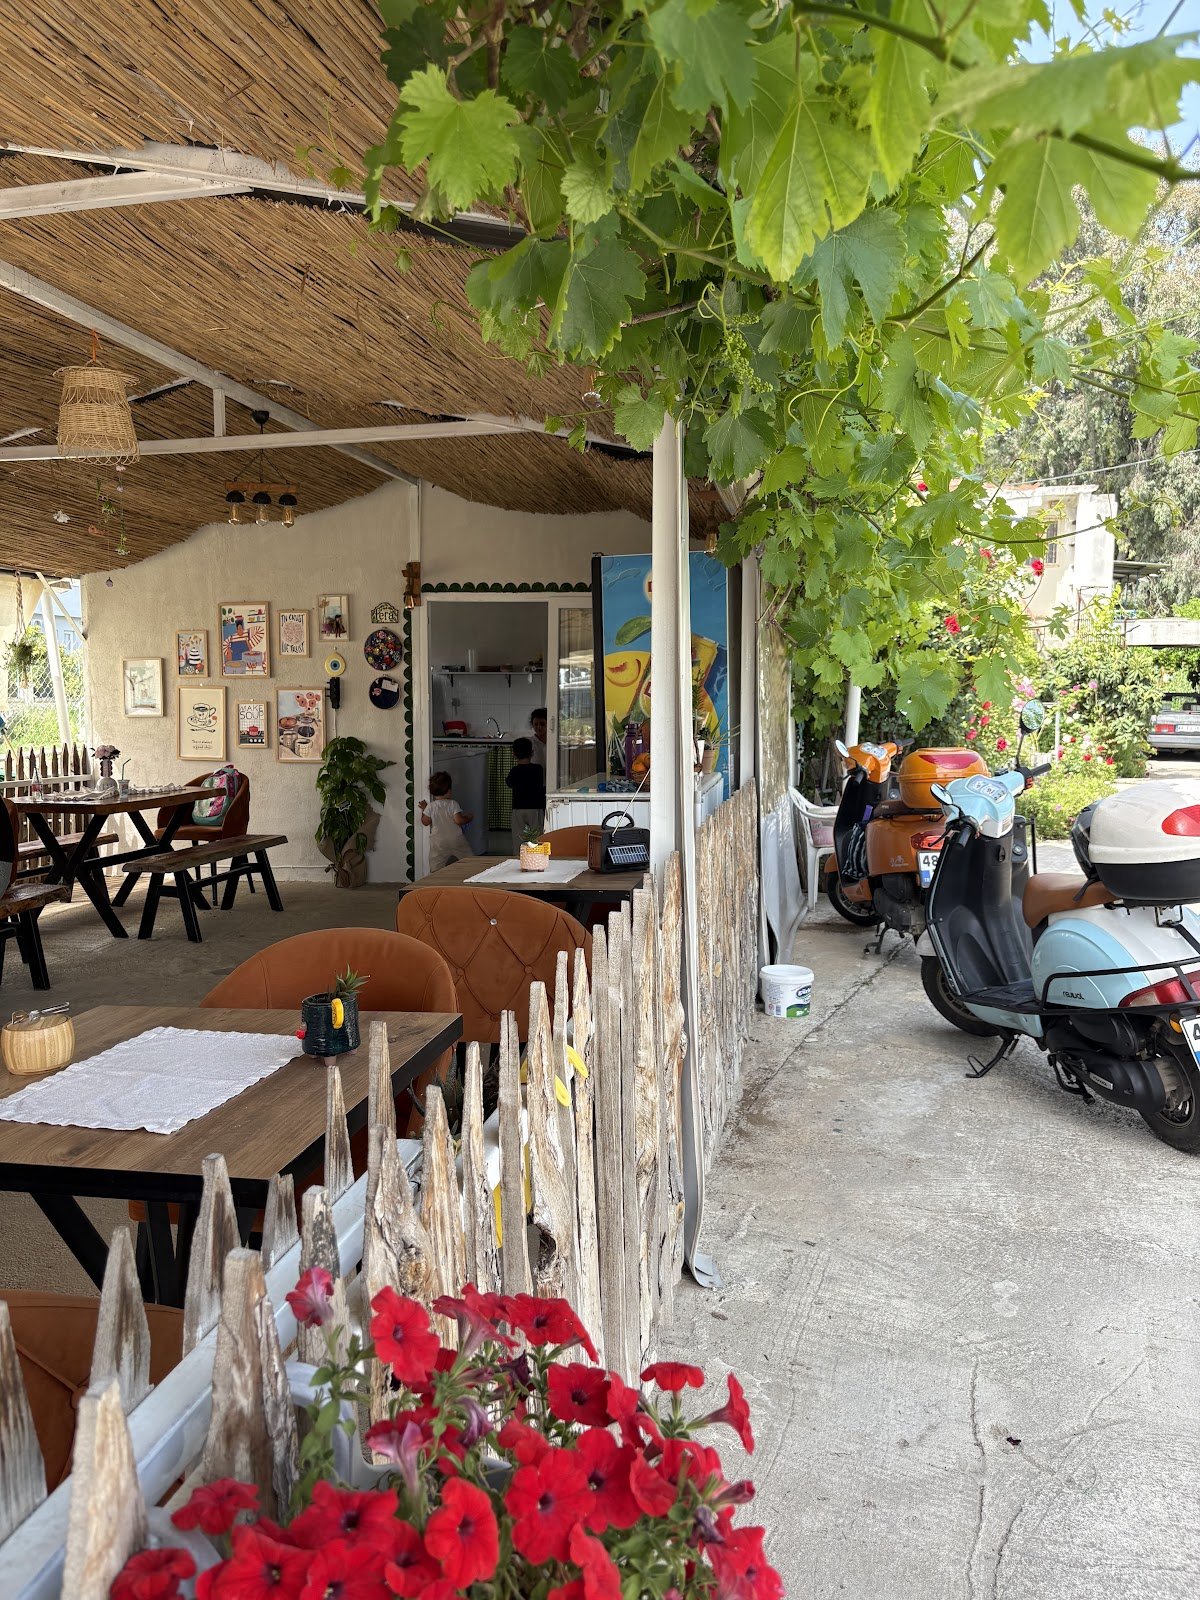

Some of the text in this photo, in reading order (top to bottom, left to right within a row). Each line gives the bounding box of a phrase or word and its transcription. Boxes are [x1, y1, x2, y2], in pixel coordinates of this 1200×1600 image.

[239, 704, 264, 720] MAKE SOUP
[923, 855, 939, 866] 48
